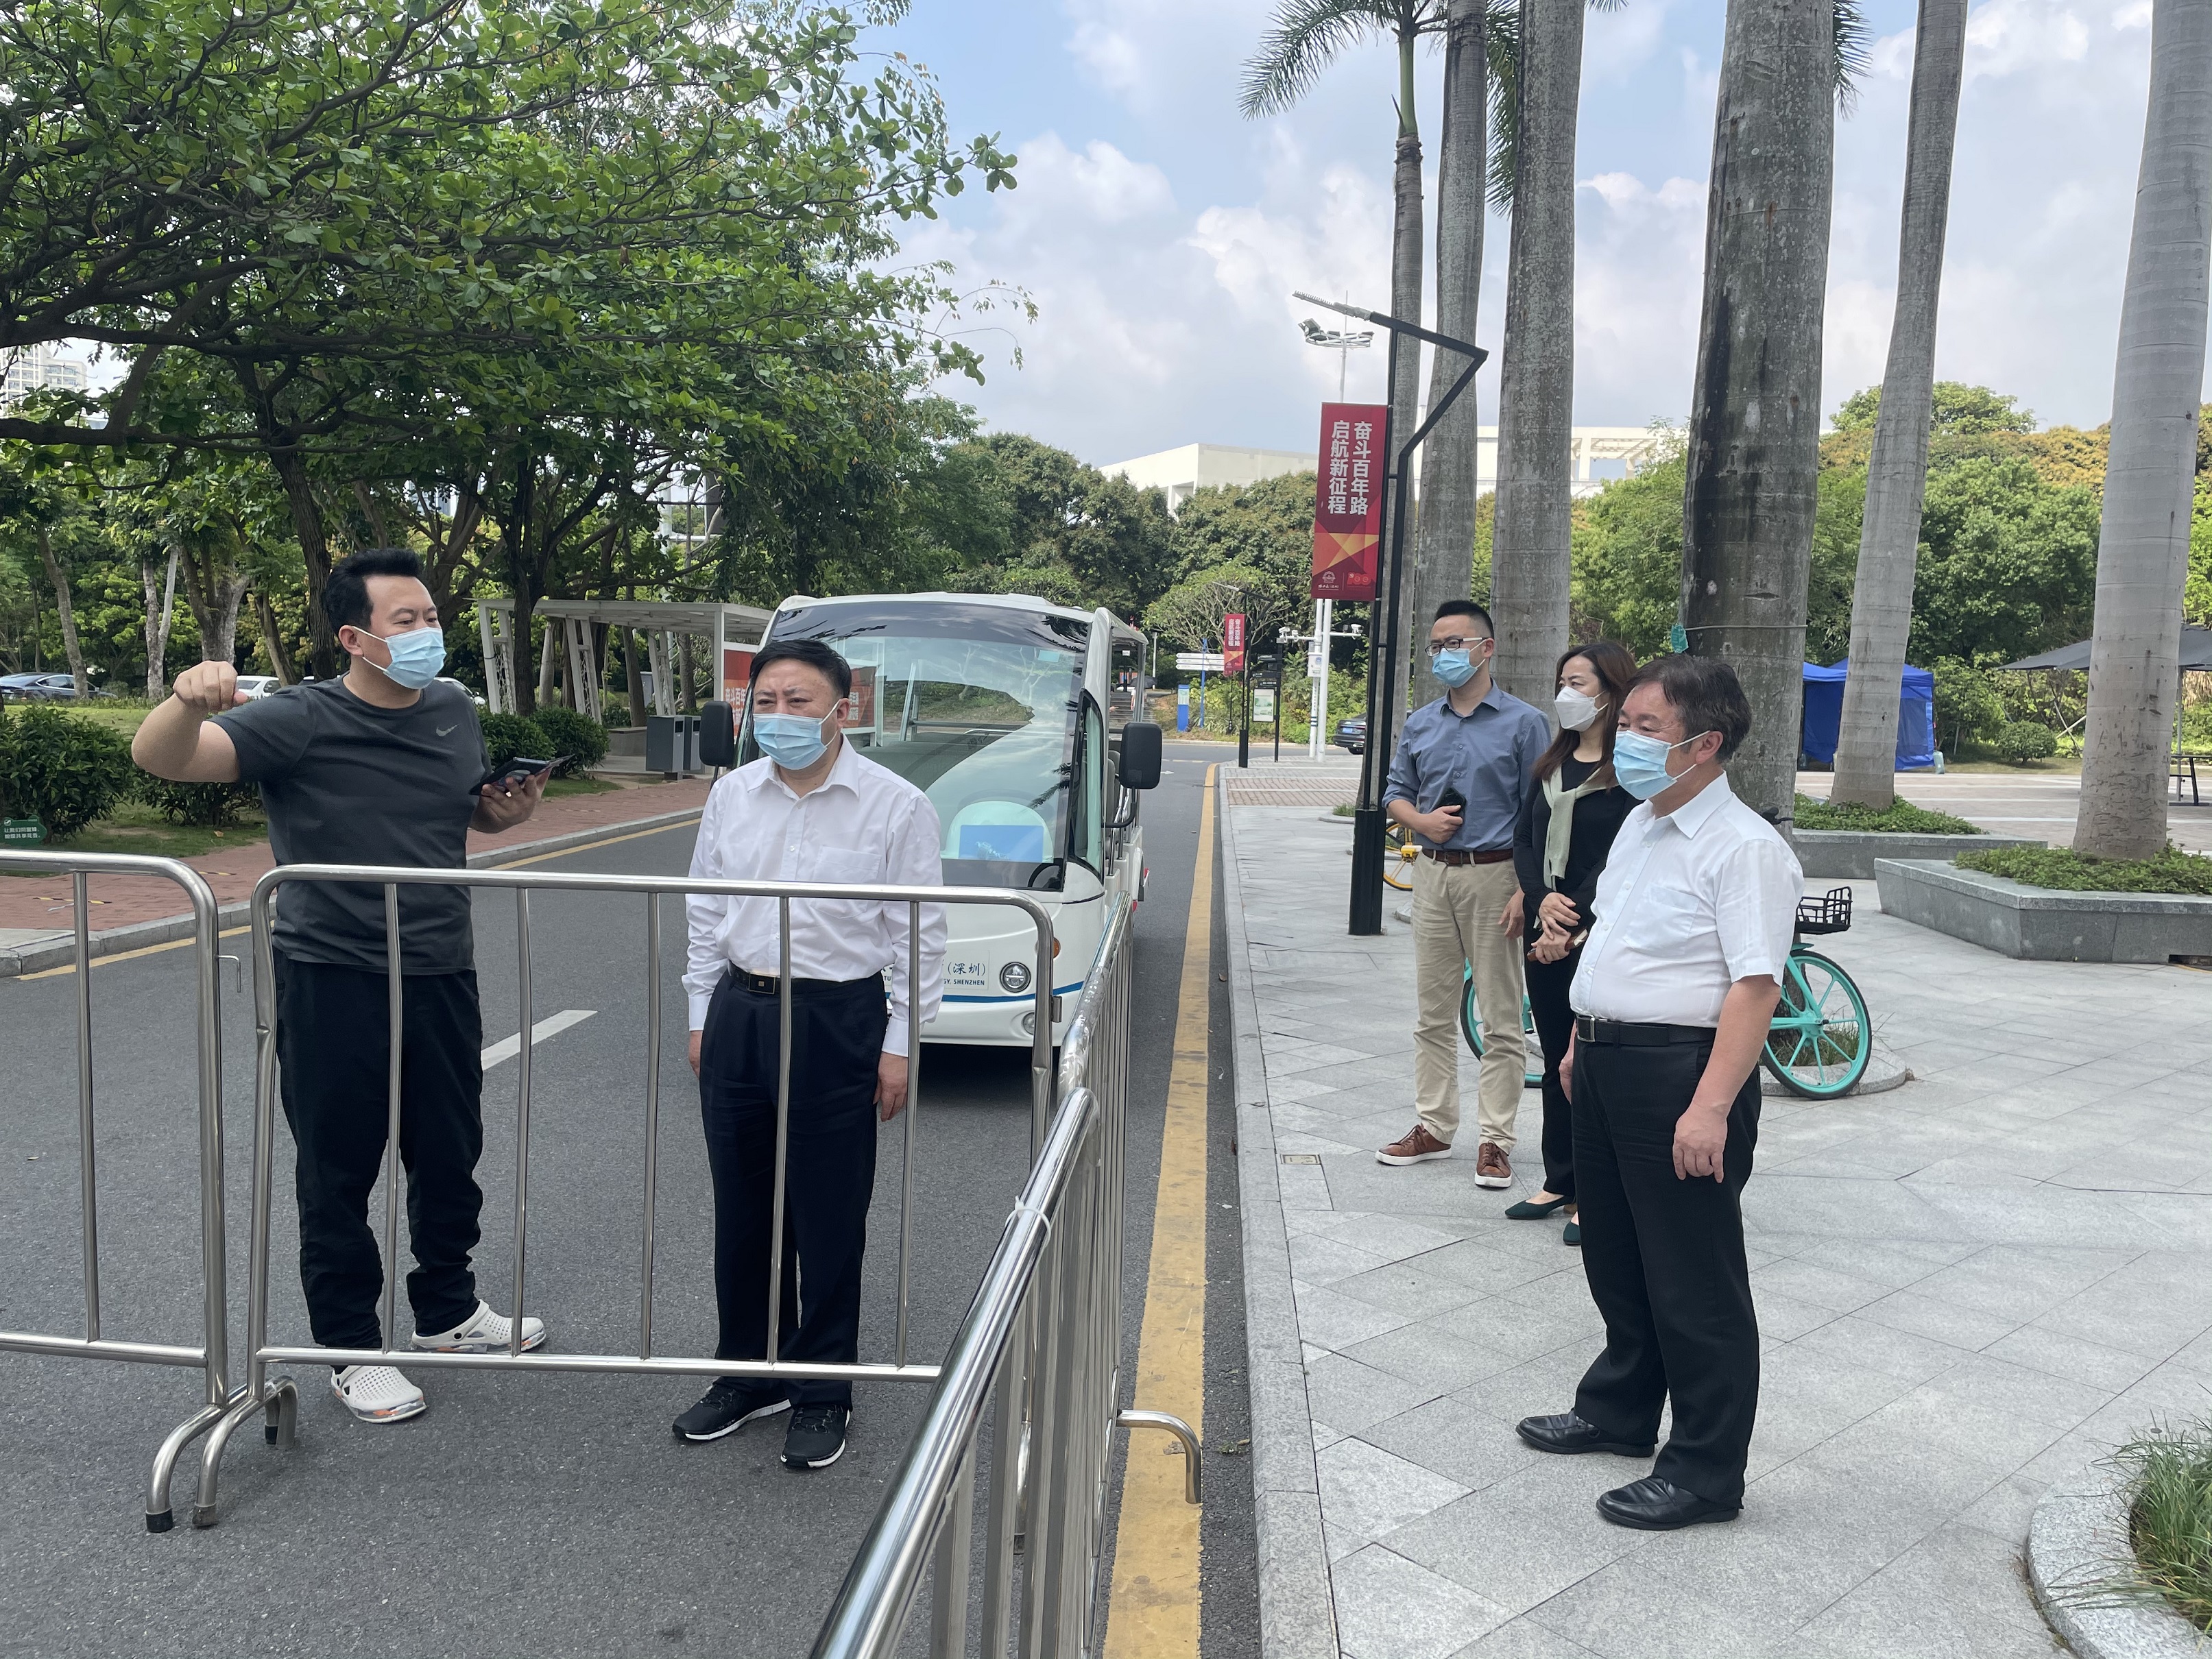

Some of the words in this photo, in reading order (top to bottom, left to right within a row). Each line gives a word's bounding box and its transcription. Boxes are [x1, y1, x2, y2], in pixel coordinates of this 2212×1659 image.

[1328, 420, 1349, 514] 启航新征程
[1349, 421, 1372, 515] 奋斗百年路
[942, 959, 986, 976] (深圳)
